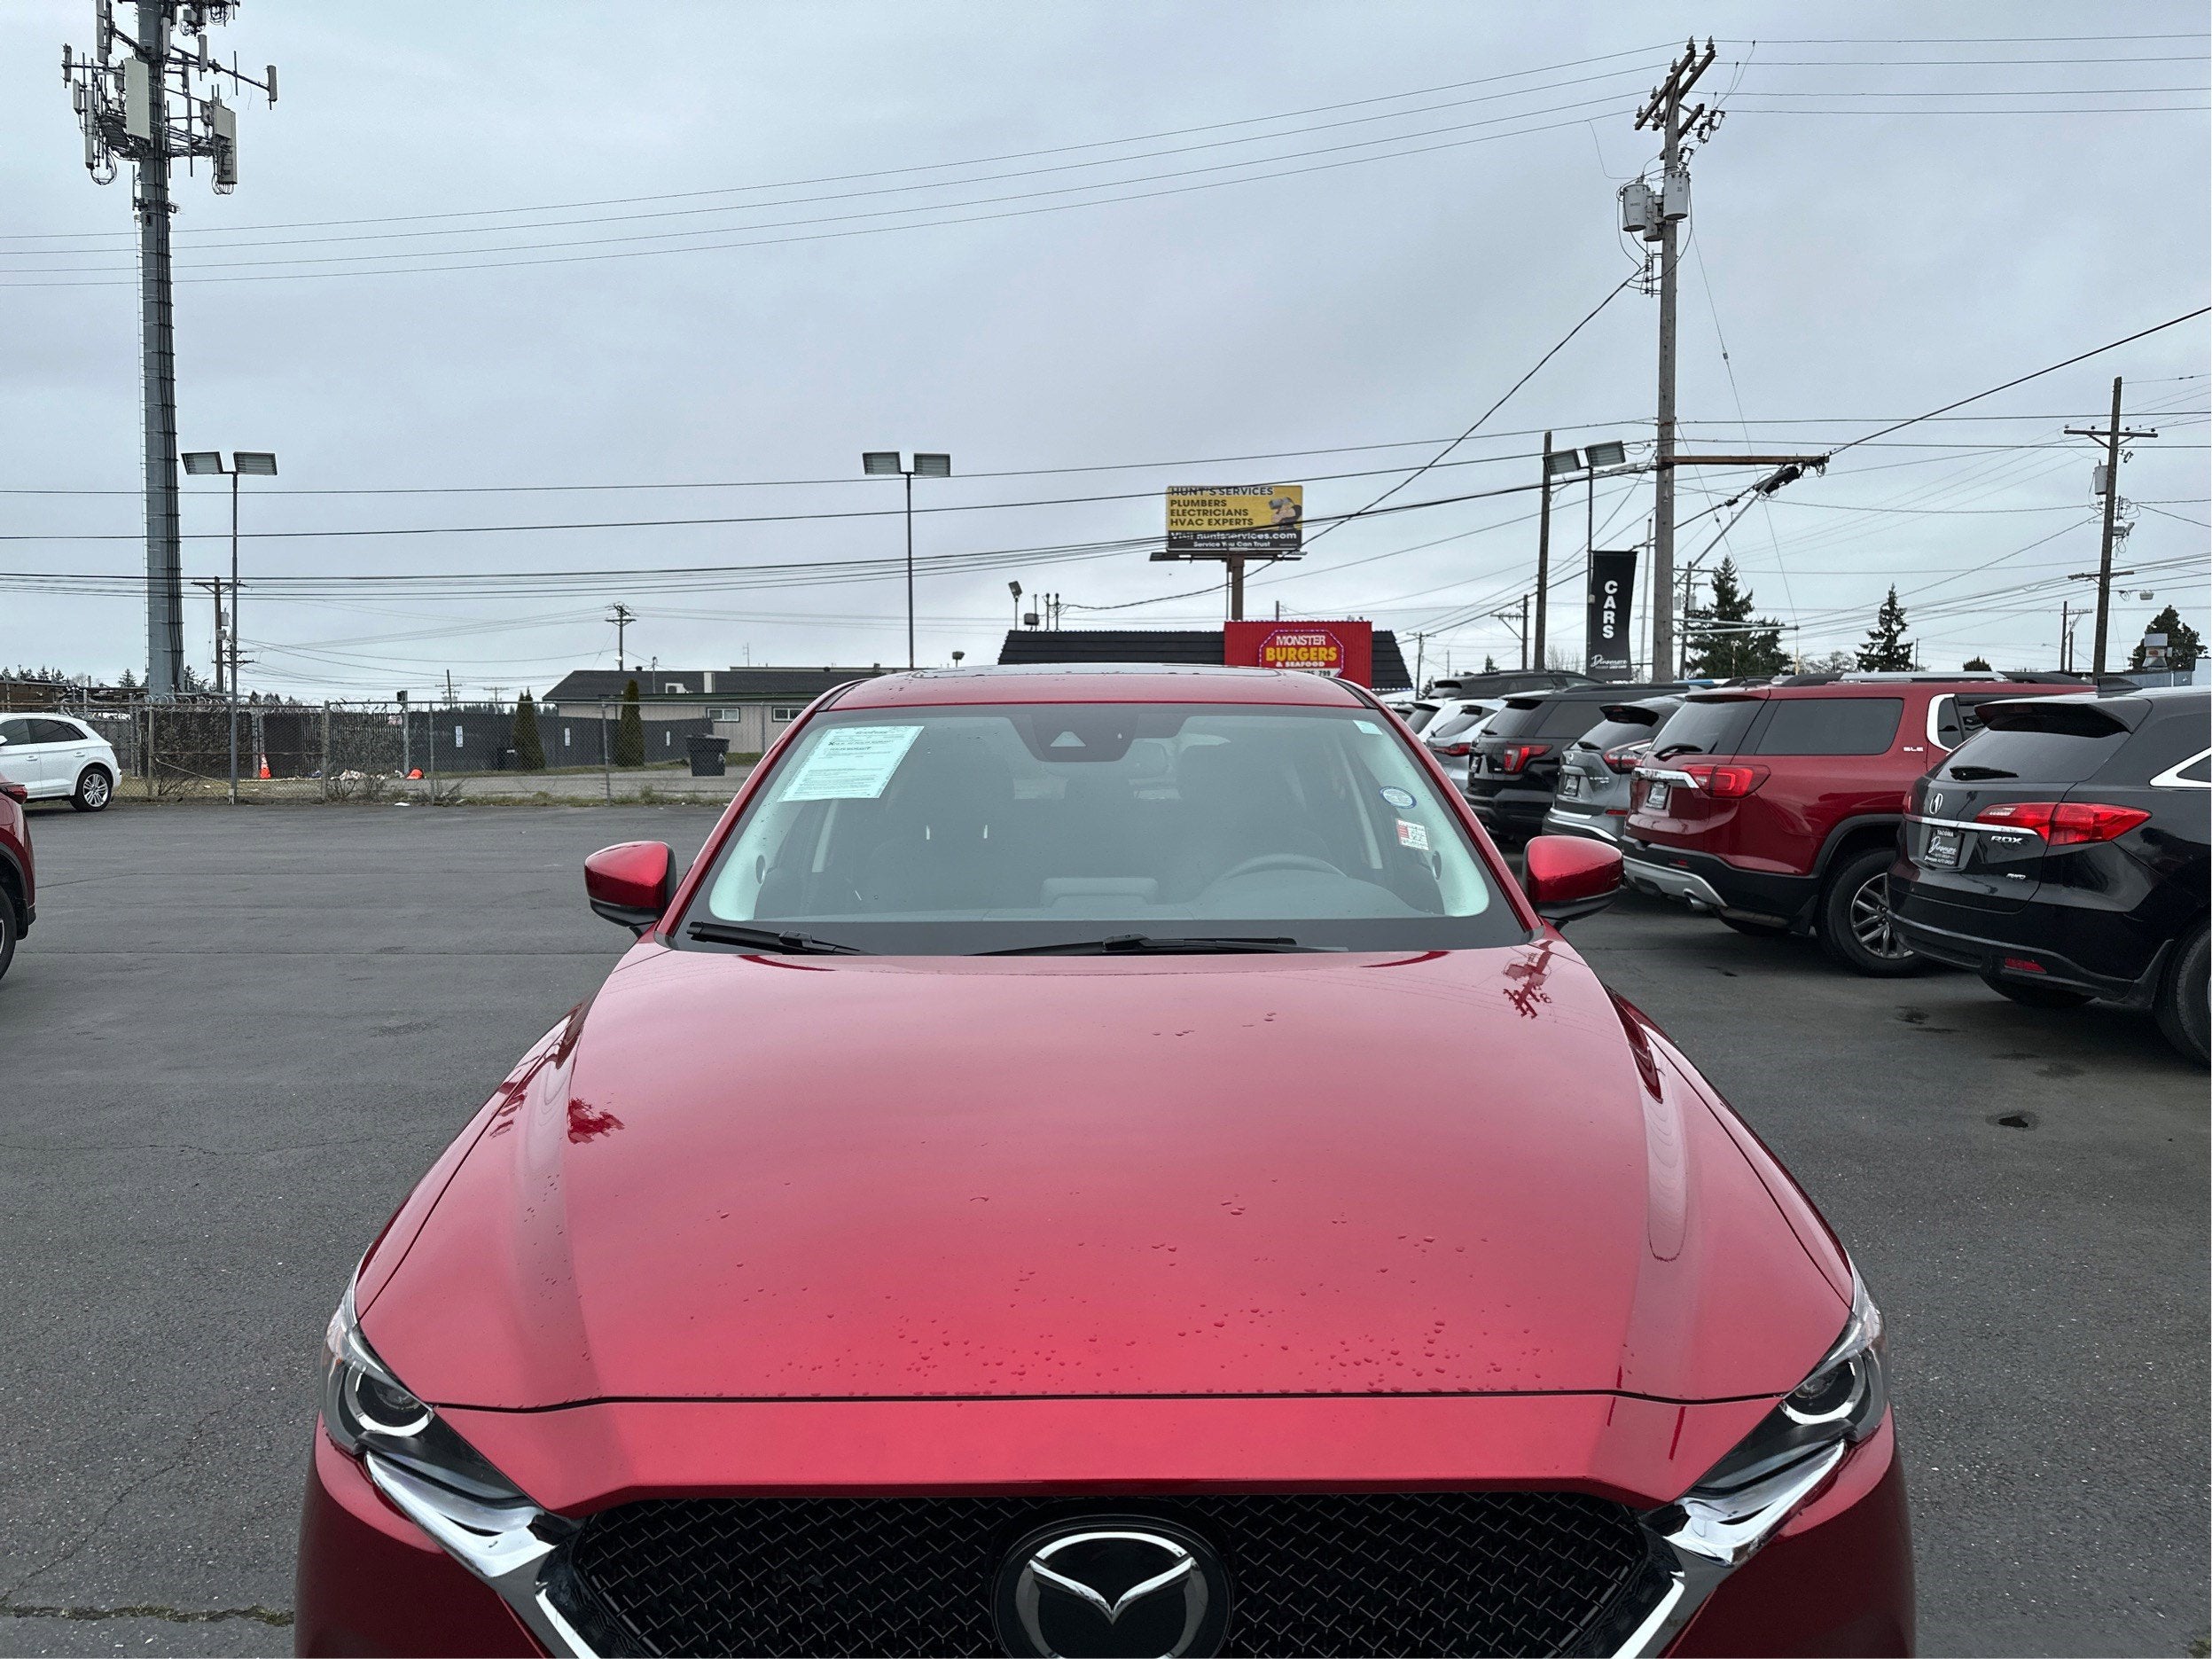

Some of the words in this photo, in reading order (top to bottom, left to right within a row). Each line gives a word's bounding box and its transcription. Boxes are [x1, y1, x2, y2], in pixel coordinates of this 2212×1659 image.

[1218, 487, 1273, 496] SERVICES
[1170, 508, 1248, 517] ELECTRICIANS
[1170, 518, 1204, 527] HVAC
[1602, 580, 1619, 639] CARS
[1276, 636, 1325, 646] MONSTER
[1266, 647, 1337, 661] BURGERS
[1990, 835, 2024, 845] RDX
